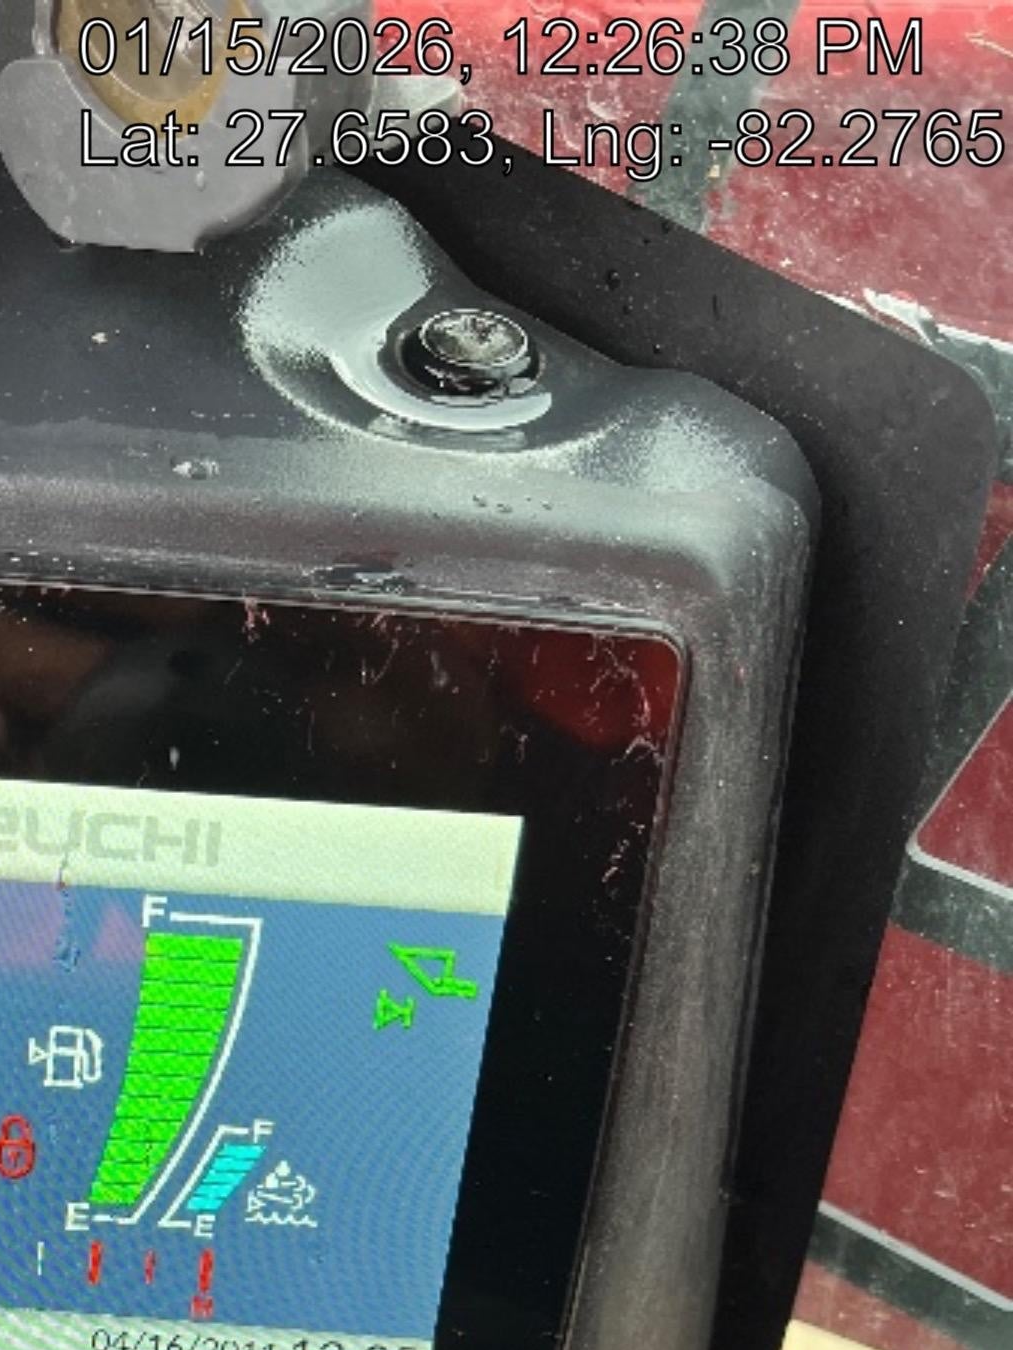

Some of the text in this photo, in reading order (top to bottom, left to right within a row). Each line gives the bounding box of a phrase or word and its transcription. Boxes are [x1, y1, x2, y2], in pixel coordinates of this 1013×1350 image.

[141, 895, 168, 928] F
[252, 1118, 275, 1144] F
[65, 1202, 89, 1231] E
[193, 1213, 216, 1238] E
